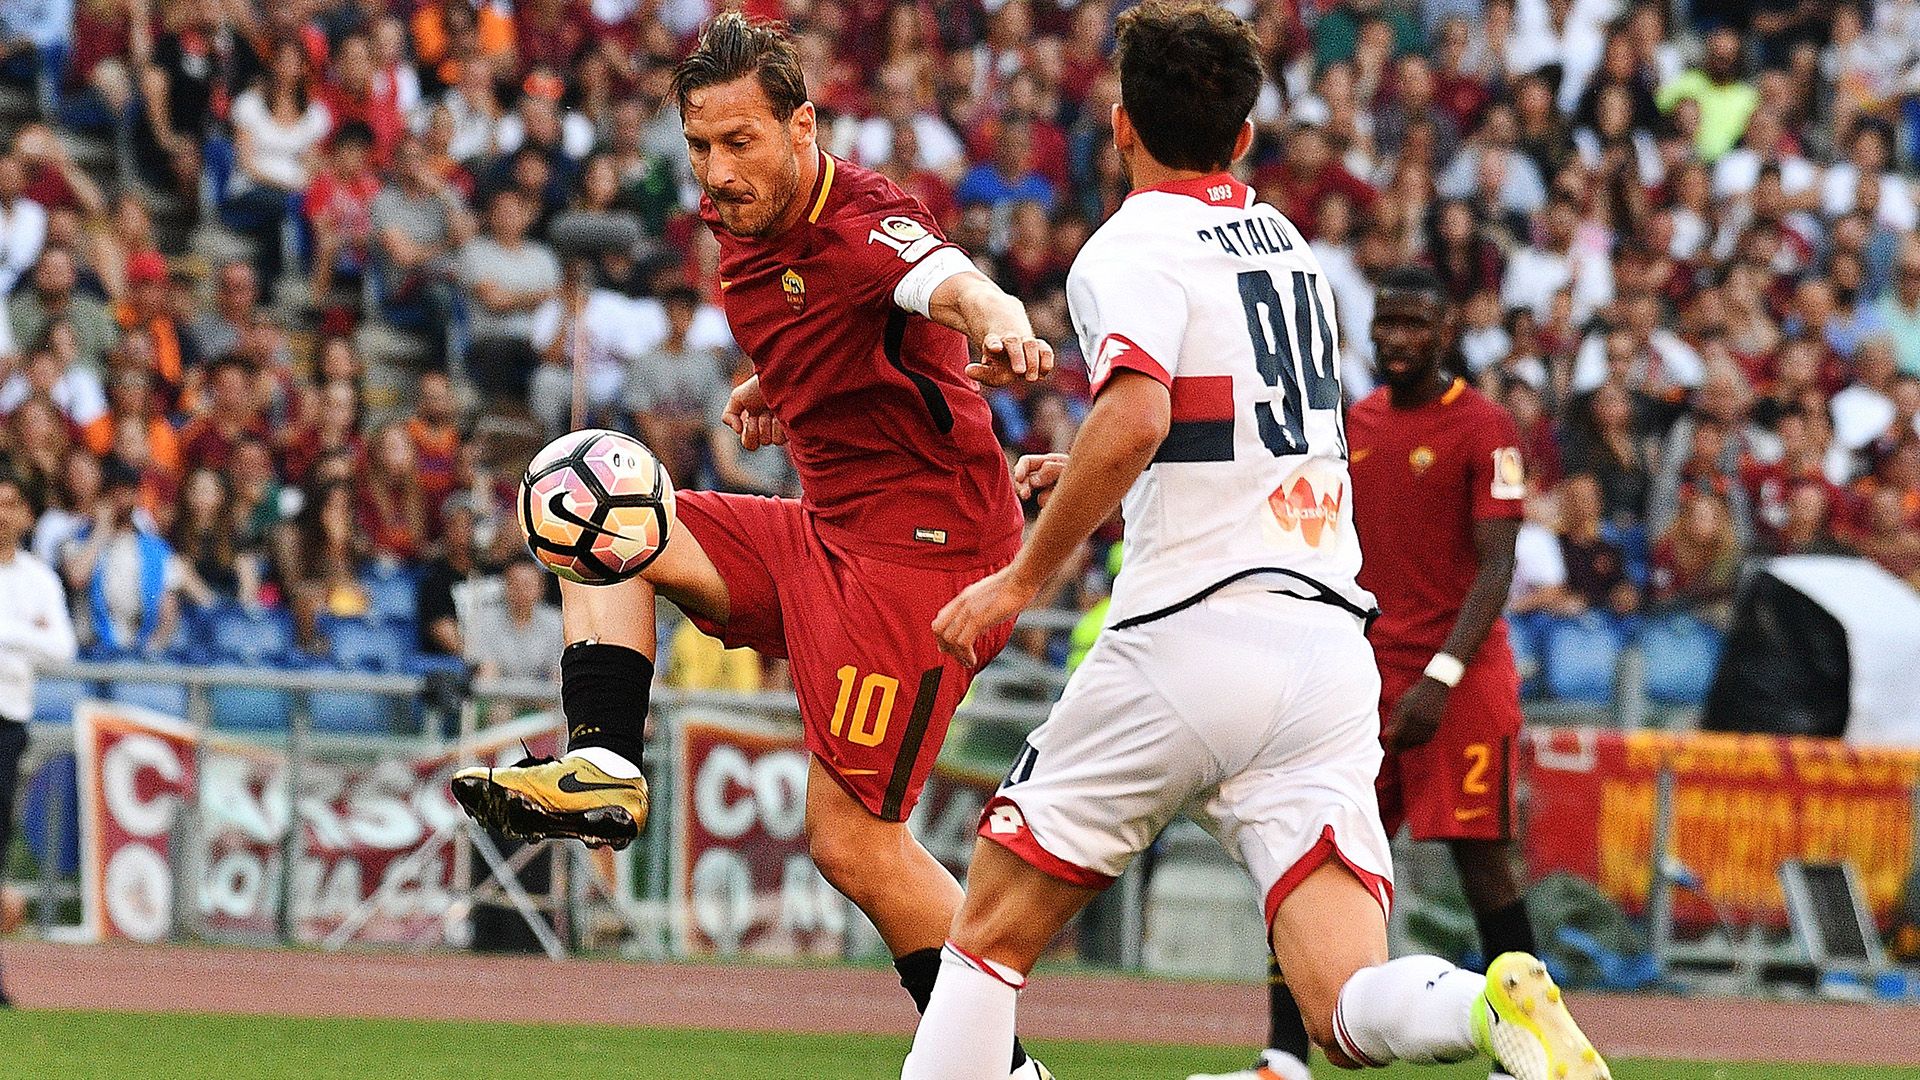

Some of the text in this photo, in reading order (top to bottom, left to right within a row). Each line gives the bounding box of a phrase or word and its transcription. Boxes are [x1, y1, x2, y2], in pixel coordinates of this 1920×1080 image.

[1206, 184, 1233, 202] 1893
[1237, 270, 1341, 458] 94
[830, 664, 899, 748] 10
[1463, 743, 1489, 794] 2
